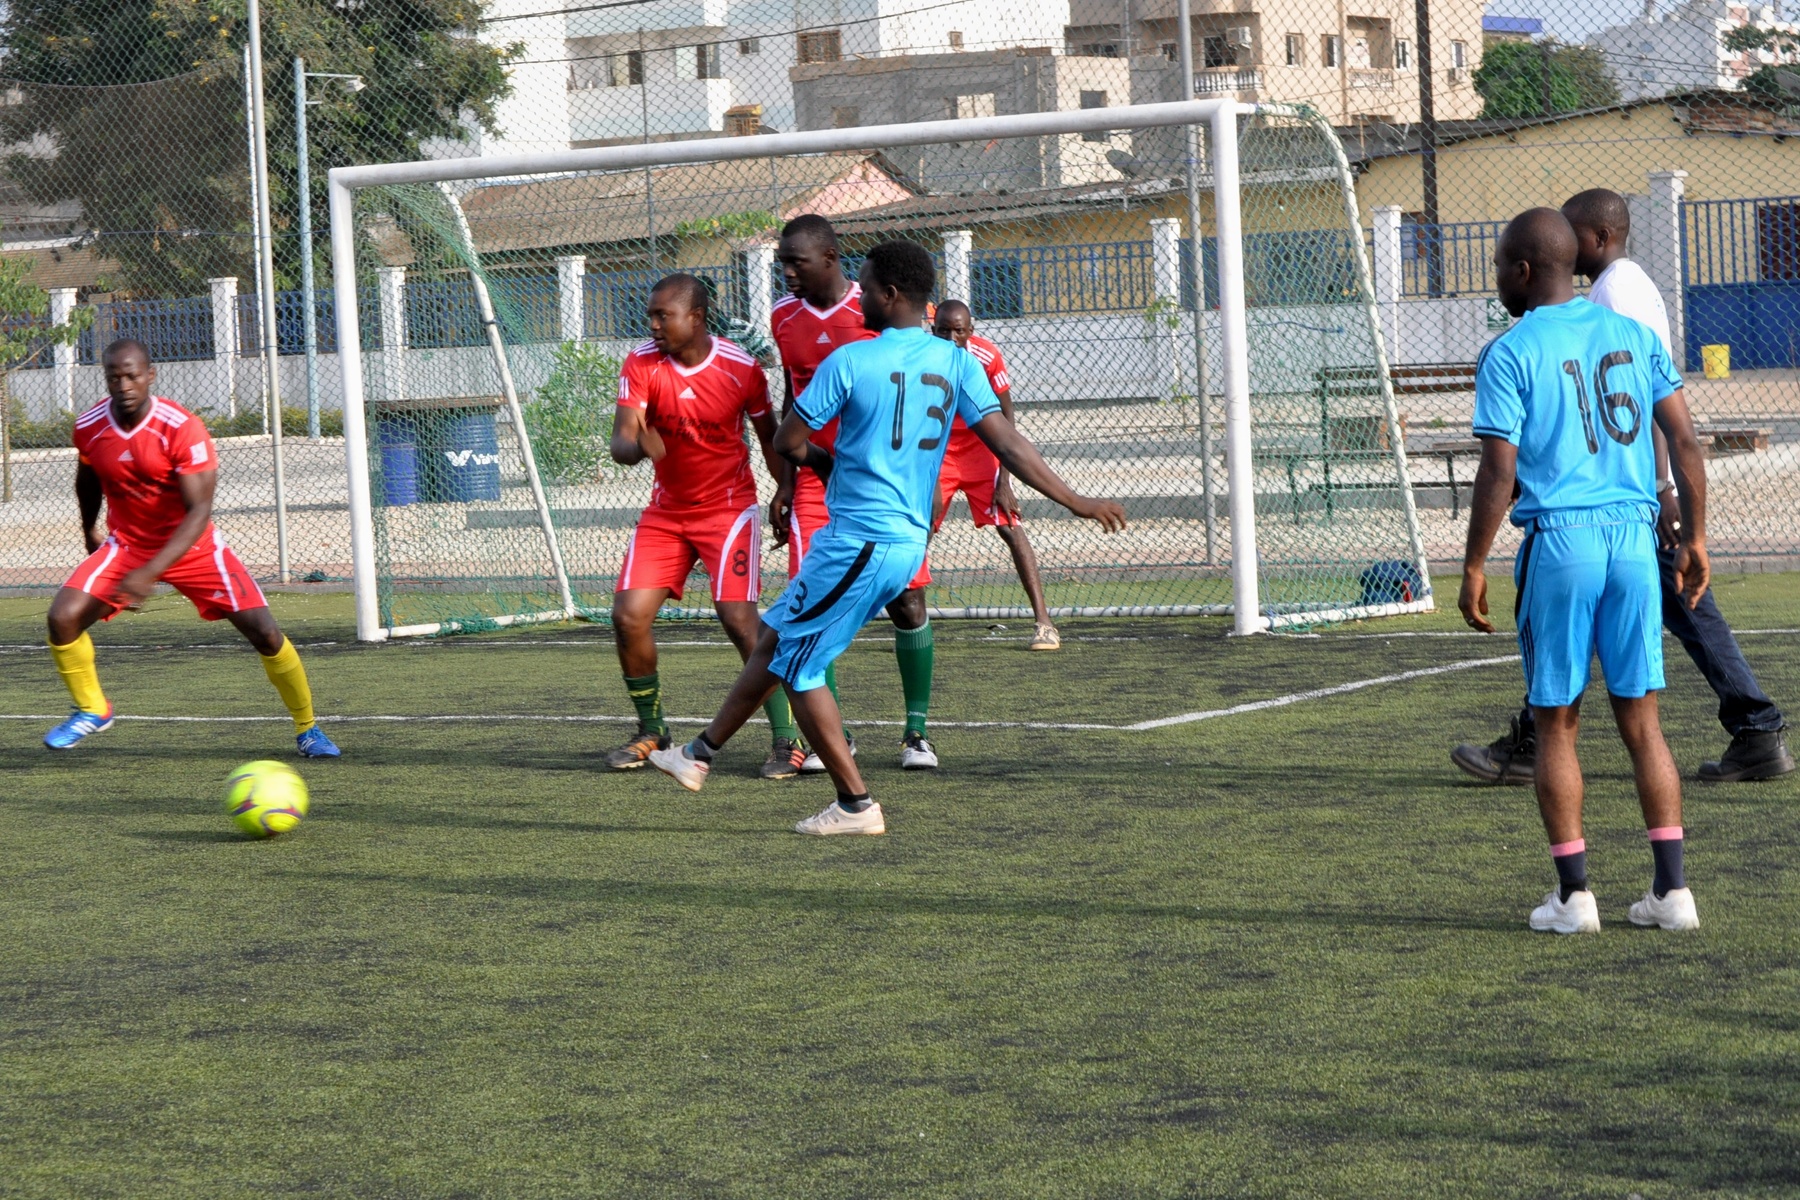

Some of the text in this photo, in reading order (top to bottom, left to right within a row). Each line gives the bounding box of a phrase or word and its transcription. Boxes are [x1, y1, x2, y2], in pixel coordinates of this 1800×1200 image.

[890, 371, 955, 451] 13
[1562, 350, 1641, 455] 16
[732, 549, 748, 576] 8
